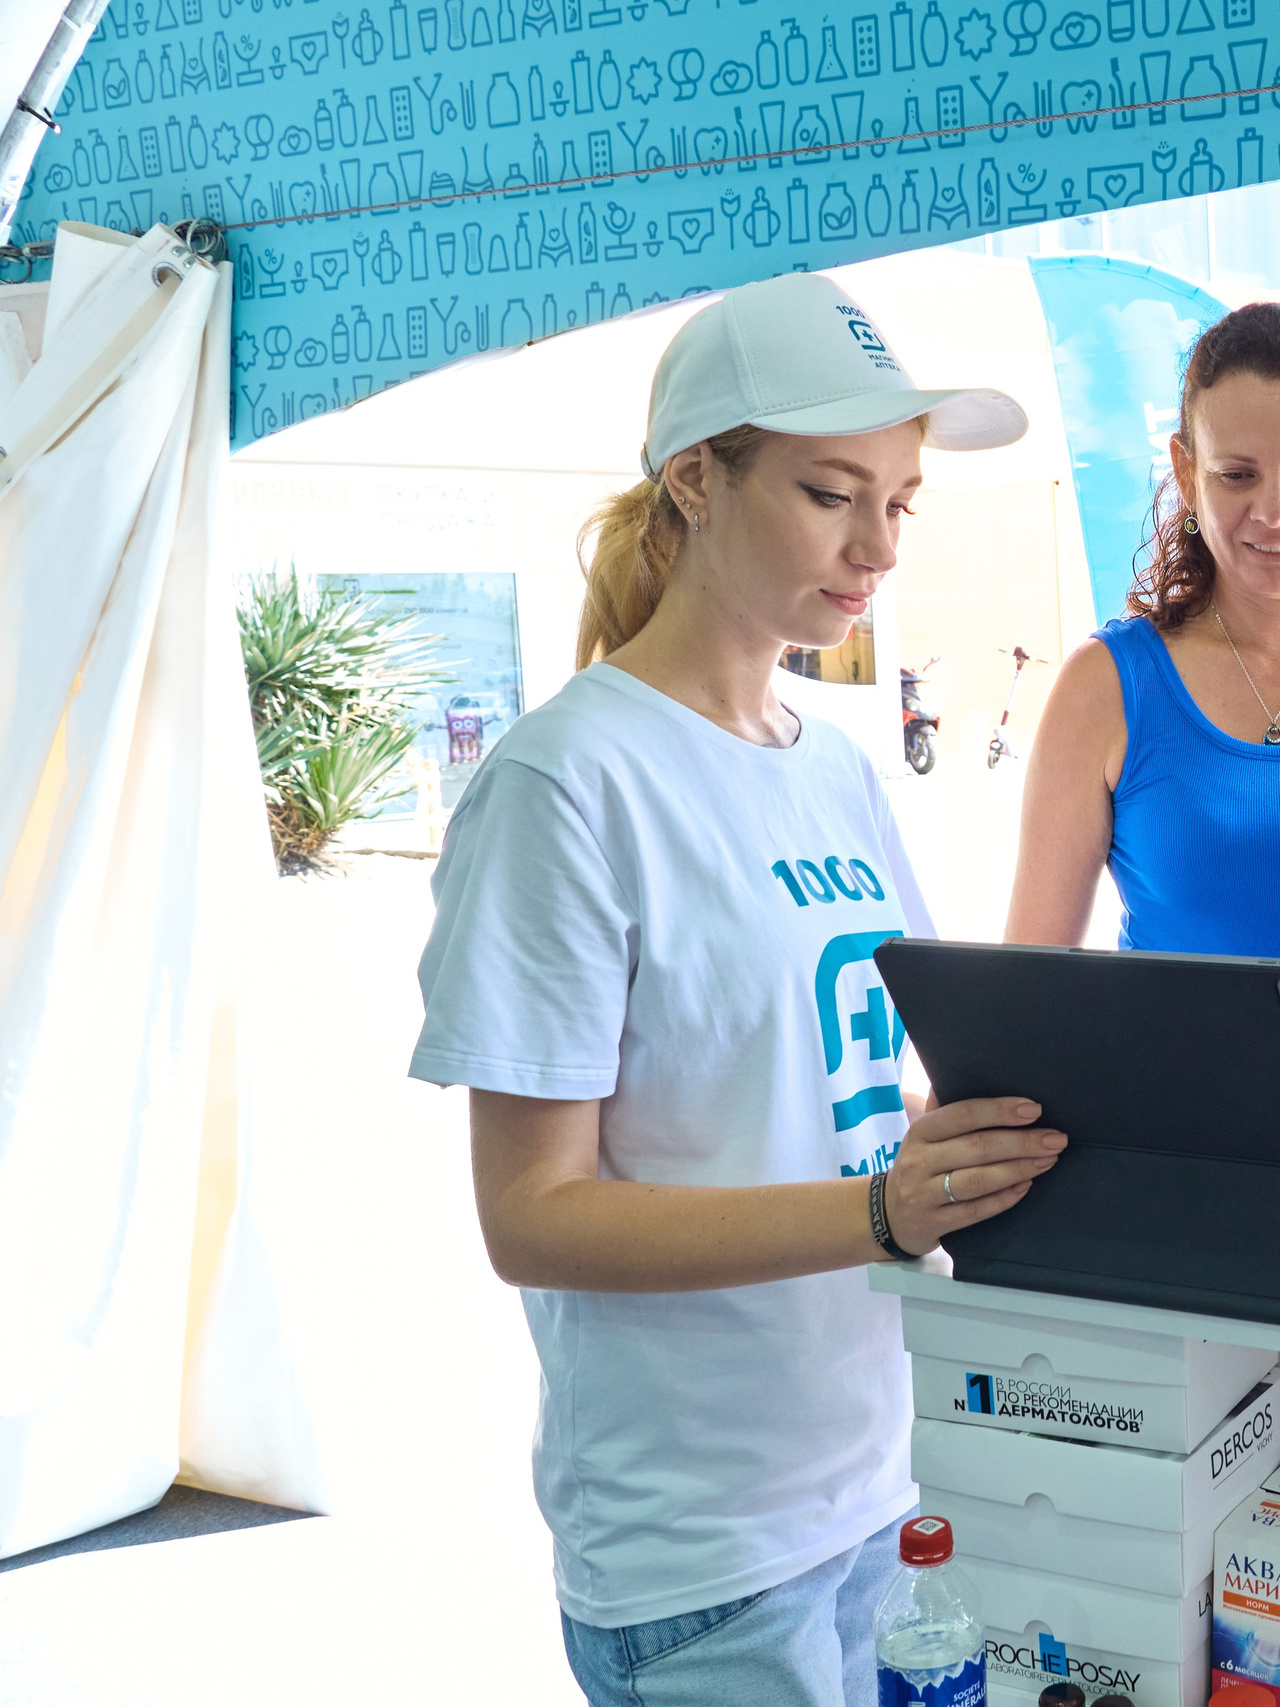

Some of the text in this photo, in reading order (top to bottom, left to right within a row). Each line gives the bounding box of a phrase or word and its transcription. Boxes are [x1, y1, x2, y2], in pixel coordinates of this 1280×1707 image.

[836, 305, 866, 319] 1000
[771, 855, 885, 907] 1000
[996, 1377, 1071, 1399] В РОССИИ
[996, 1390, 1145, 1422] ПО РЕКОМЕНДАЦИИ
[1211, 1403, 1272, 1479] DERCOS
[1256, 1431, 1274, 1452] VICHY
[1246, 1599, 1270, 1612] НОРМ
[985, 1640, 1140, 1692] ROCHE POSAY
[1226, 1660, 1233, 1670] 6
